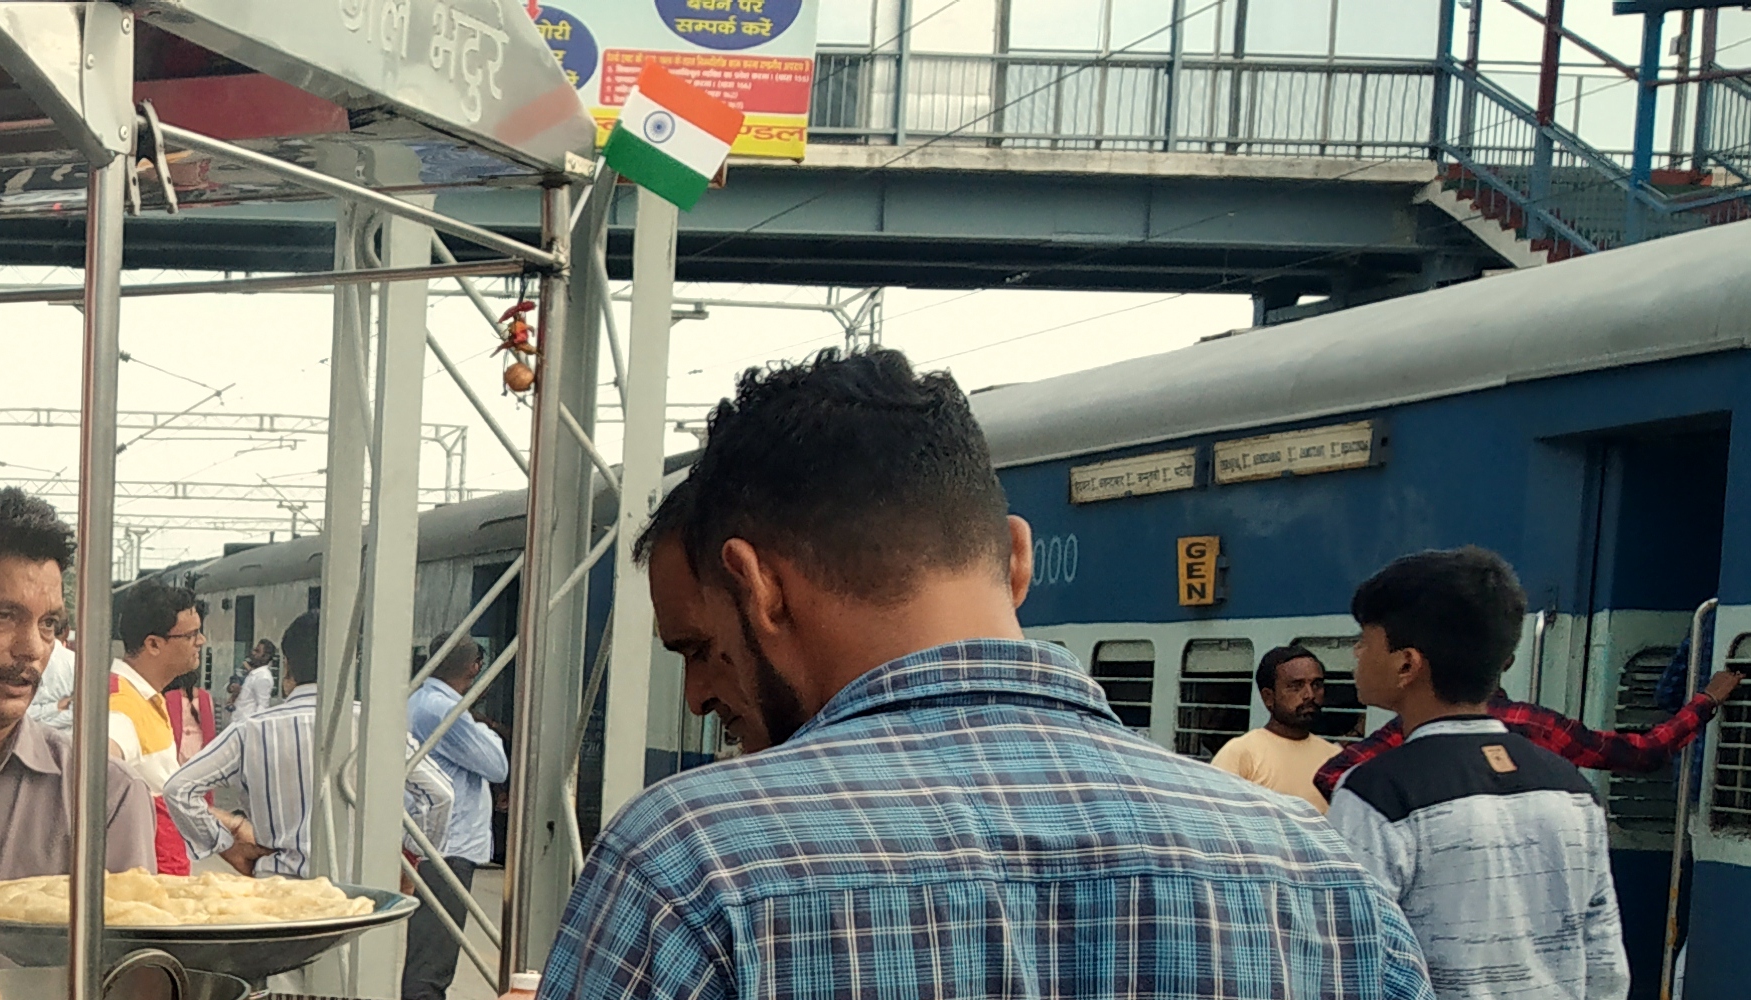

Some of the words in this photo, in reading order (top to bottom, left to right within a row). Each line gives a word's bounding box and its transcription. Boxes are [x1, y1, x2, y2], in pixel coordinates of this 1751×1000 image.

[675, 15, 738, 35] सम्पर्क
[741, 17, 774, 37] करें
[1185, 541, 1207, 600] GEN
